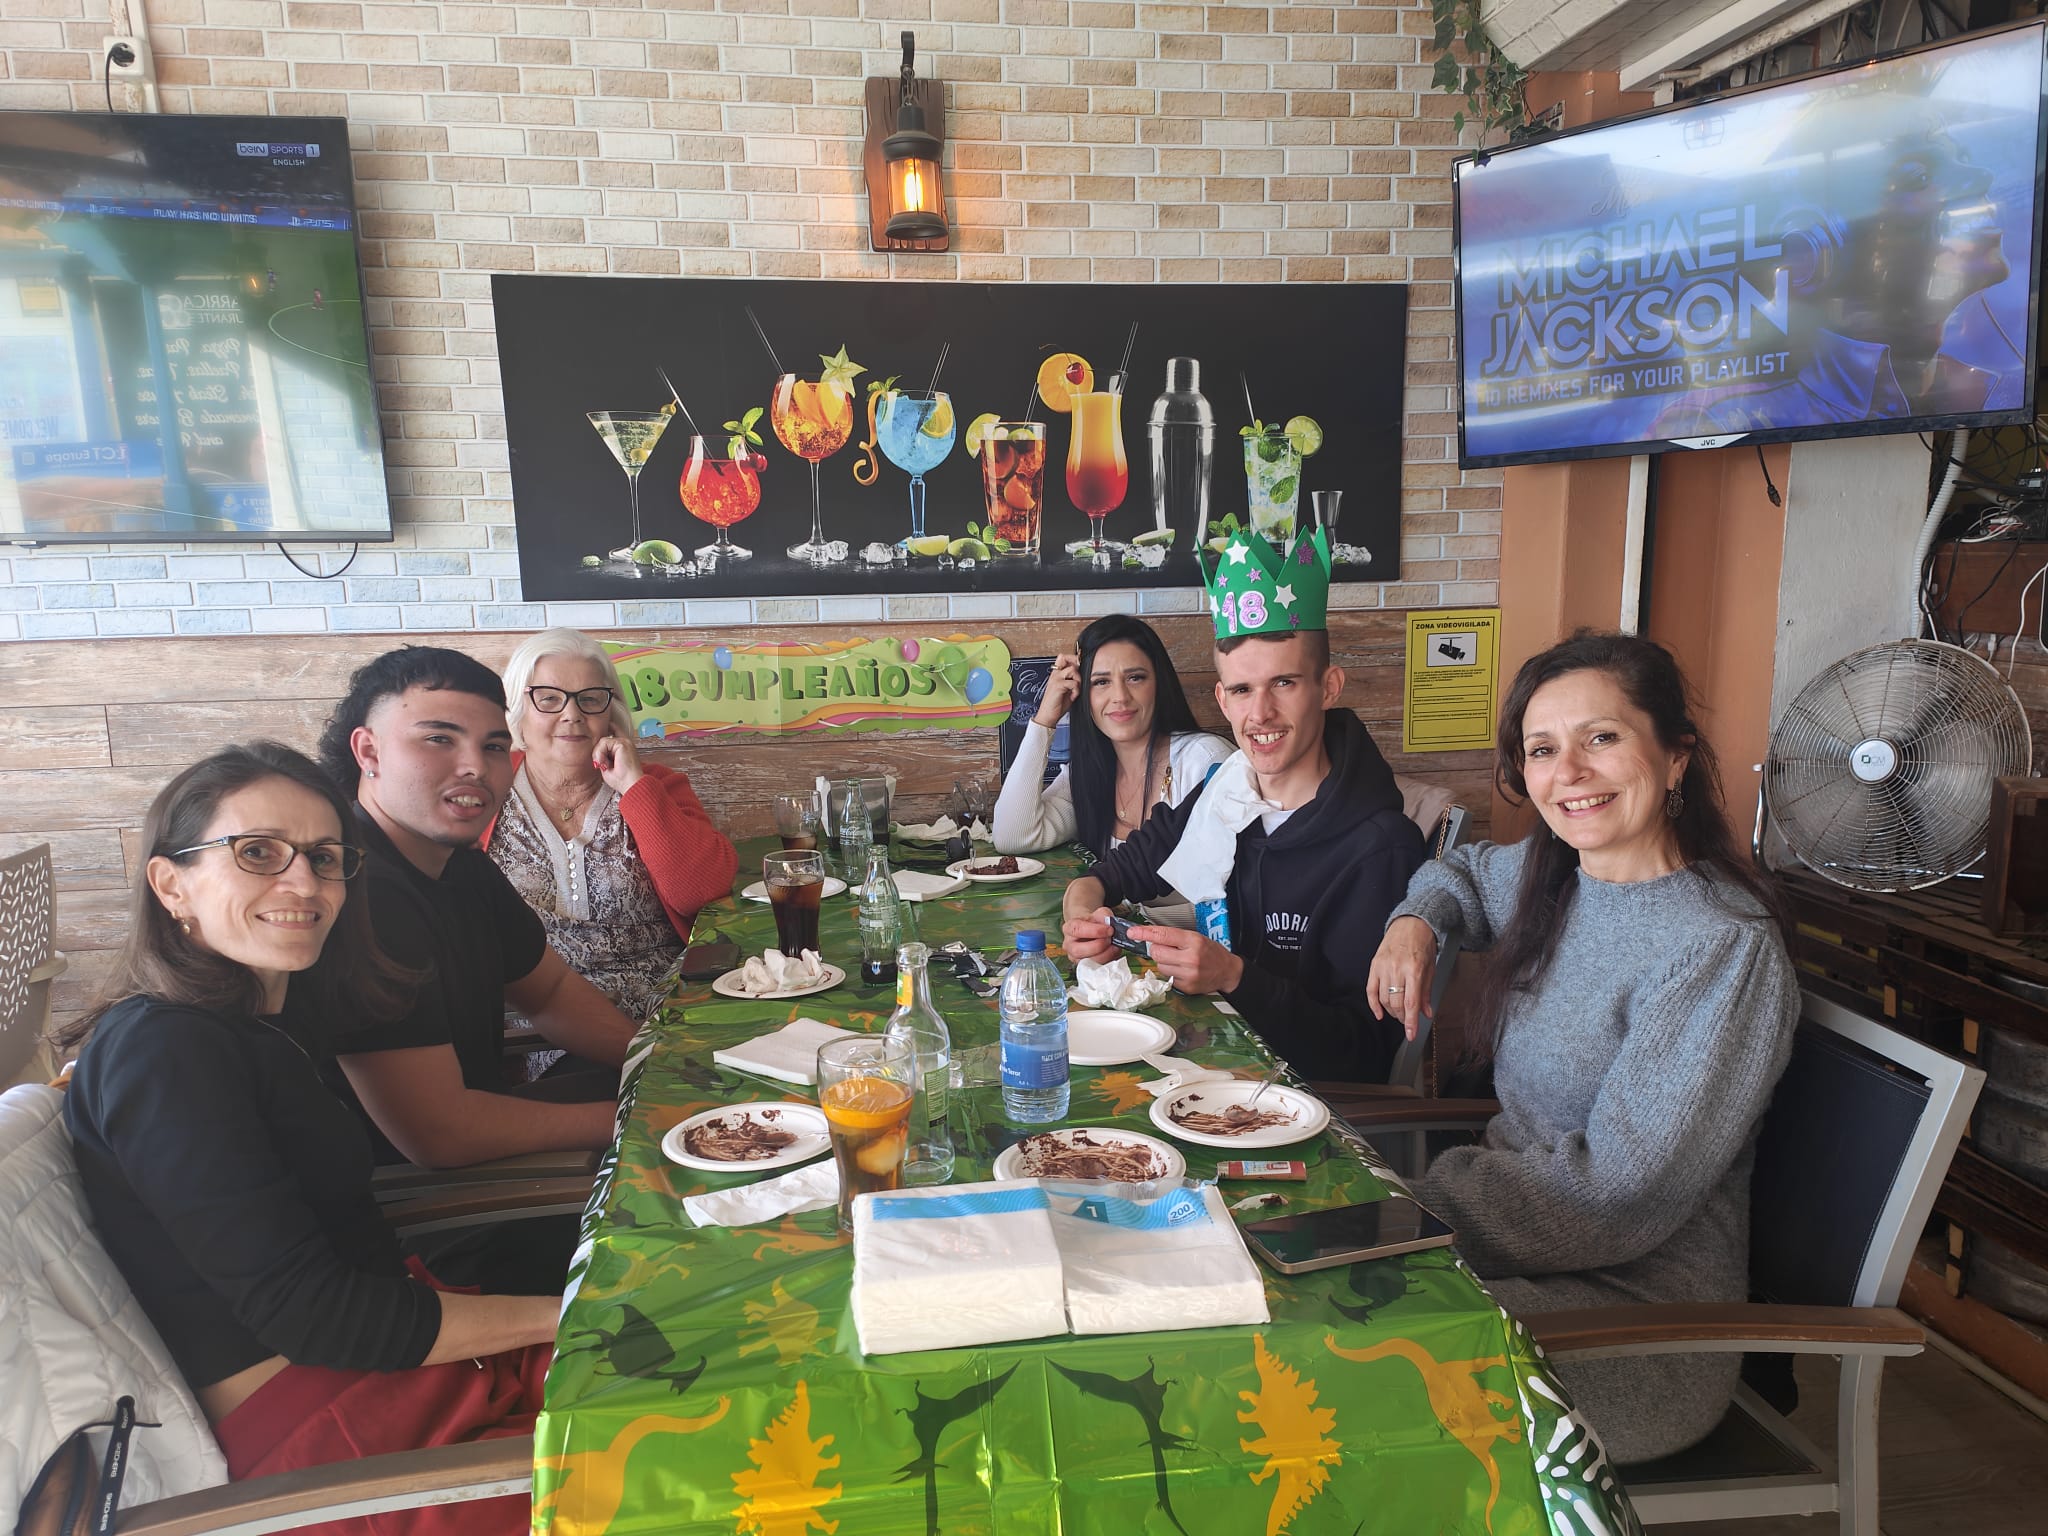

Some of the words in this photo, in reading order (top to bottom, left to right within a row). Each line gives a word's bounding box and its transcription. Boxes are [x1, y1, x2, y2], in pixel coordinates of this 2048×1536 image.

[270, 146, 304, 154] SPORTS
[1503, 204, 1781, 304] MICHAEL
[1485, 269, 1789, 373] JACKSON
[1507, 377, 1582, 405] REMIXES
[1589, 373, 1625, 395] FOR
[1632, 365, 1683, 390] YOUR
[1691, 352, 1790, 382] PLAYLIST
[1222, 591, 1268, 634] 18
[1415, 622, 1435, 630] ZONA
[1437, 621, 1490, 629] VIDEOVIGILADA
[1086, 1205, 1098, 1218] 1
[1170, 1203, 1190, 1219] 200
